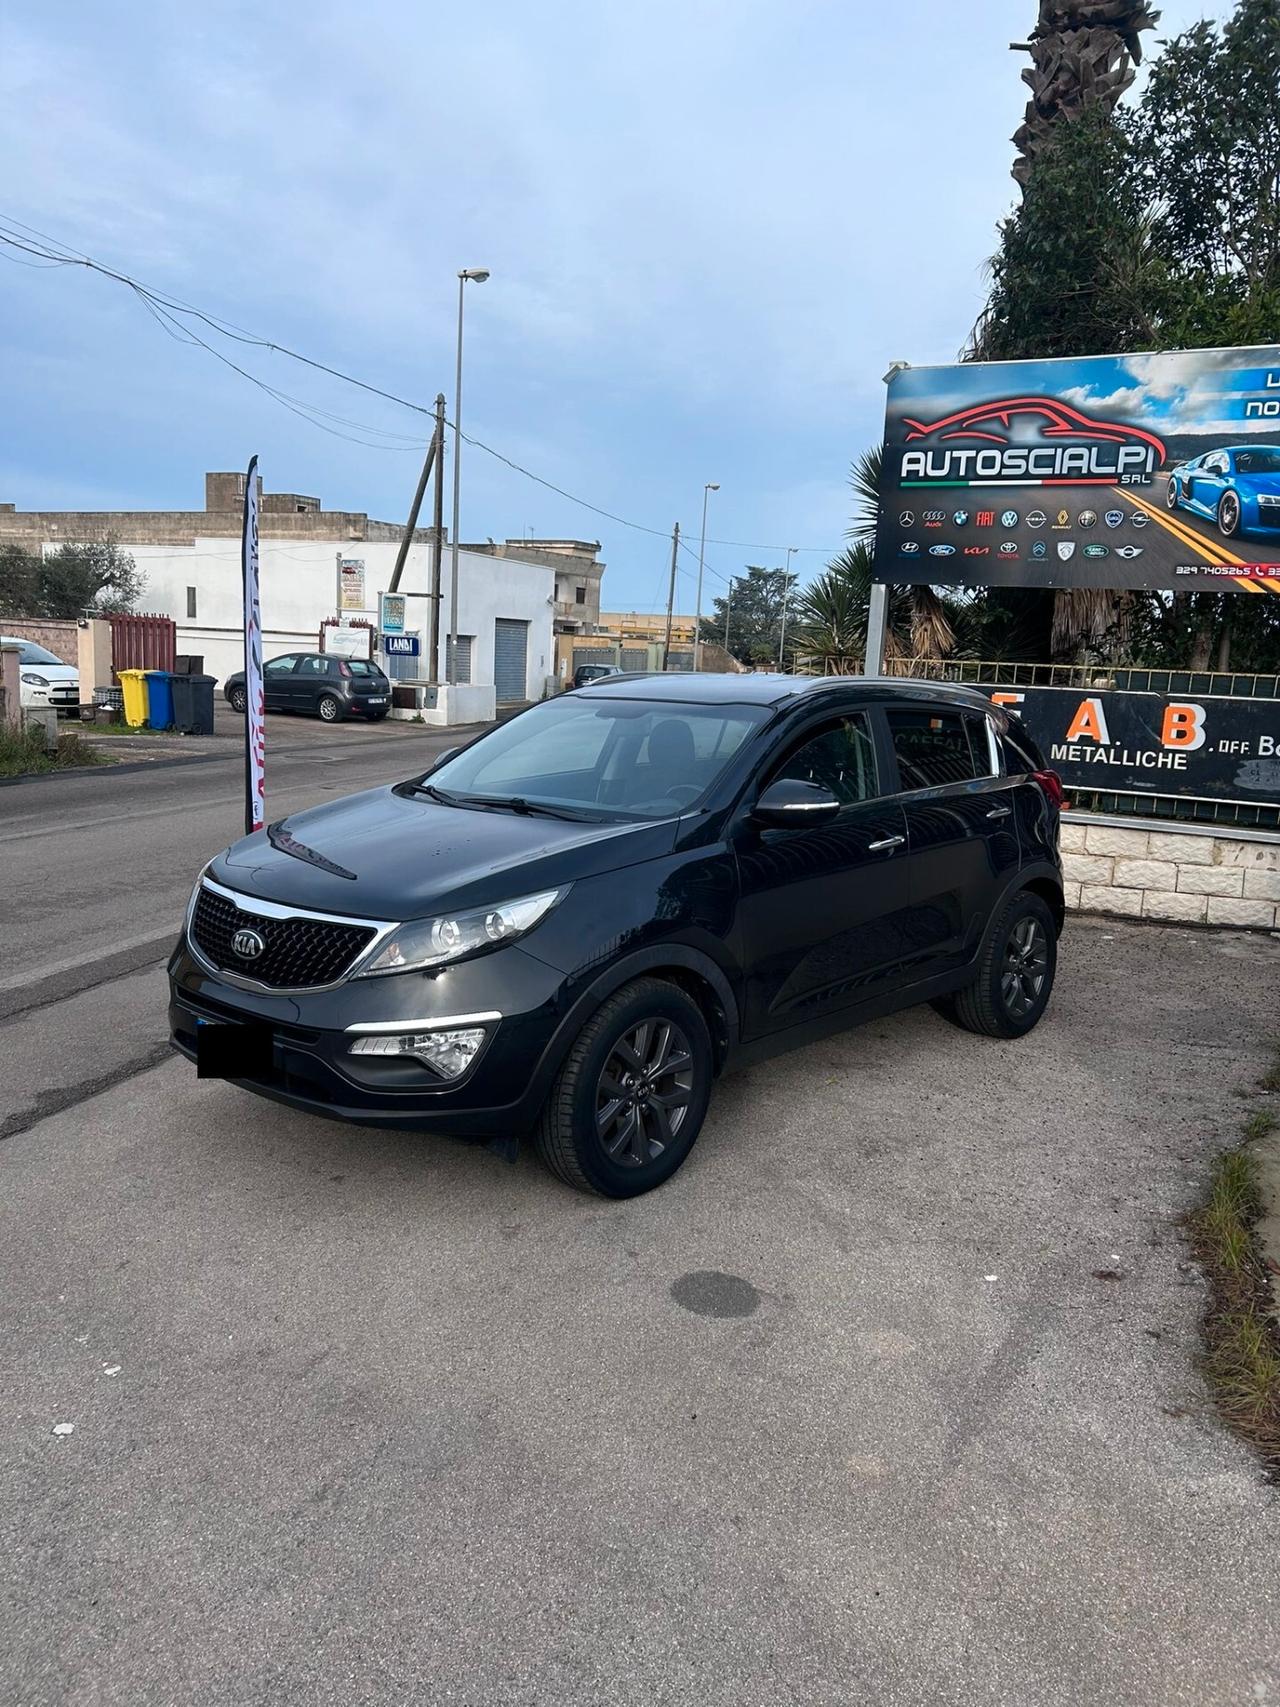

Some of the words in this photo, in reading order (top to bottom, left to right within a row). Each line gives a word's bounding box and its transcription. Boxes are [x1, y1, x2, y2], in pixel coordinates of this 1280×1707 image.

[901, 445, 1154, 477] AUTOSCIALPI
[1121, 474, 1151, 484] SRL
[976, 511, 995, 527] FIAT
[1176, 566, 1198, 575] 329
[1200, 566, 1251, 576] 7405265
[1050, 743, 1188, 771] METALLICHE
[233, 934, 256, 955] KIA
